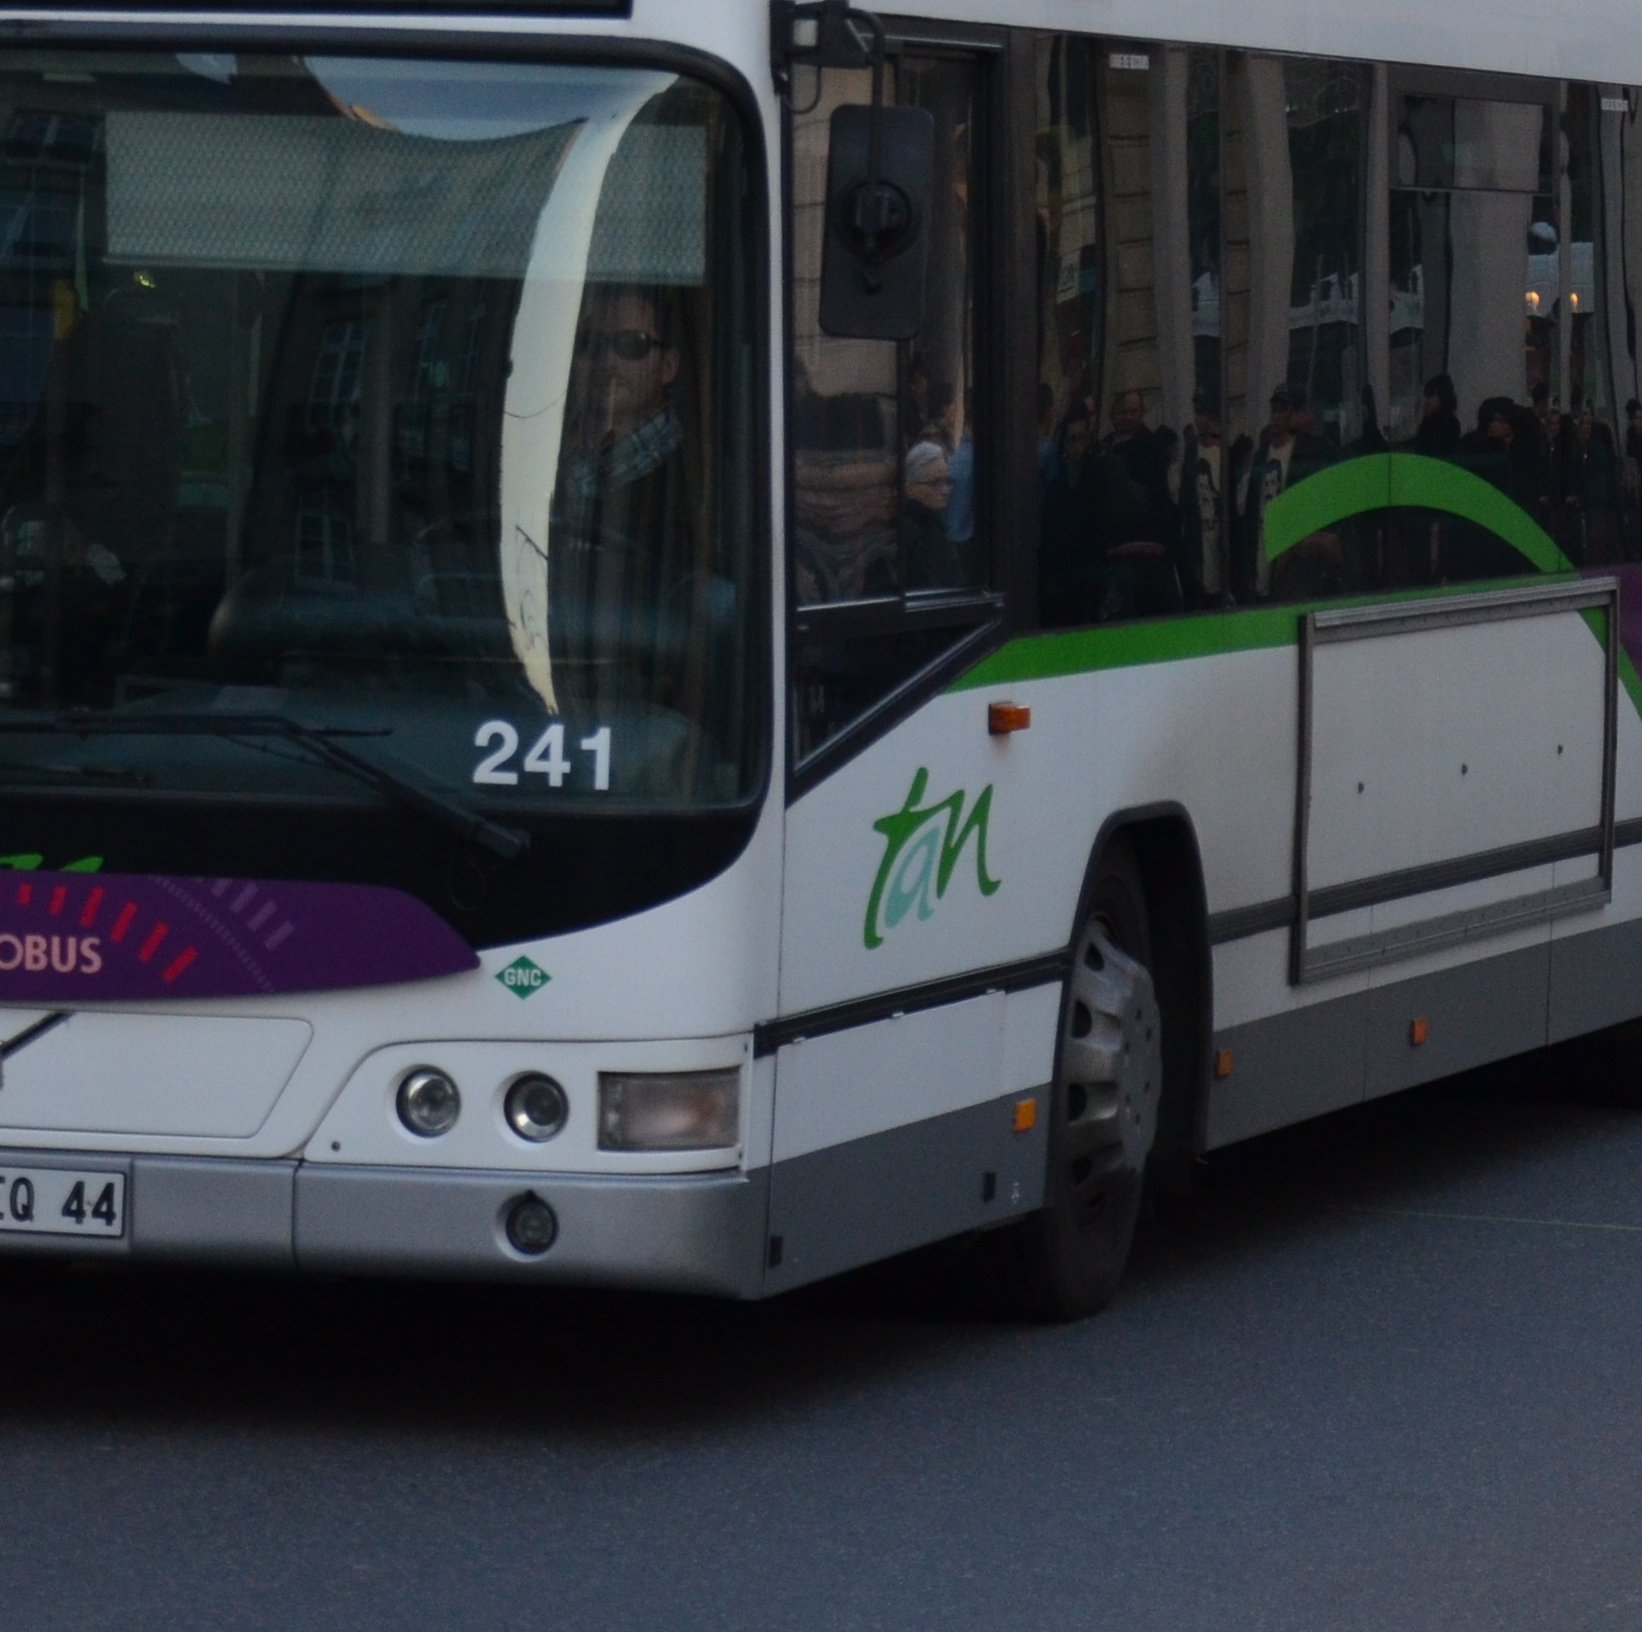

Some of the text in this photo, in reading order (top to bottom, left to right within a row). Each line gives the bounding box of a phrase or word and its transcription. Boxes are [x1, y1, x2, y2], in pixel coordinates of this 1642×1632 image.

[473, 720, 611, 791] 241
[863, 766, 1002, 950] tan
[503, 967, 542, 987] GNC
[61, 1180, 117, 1226] 44
